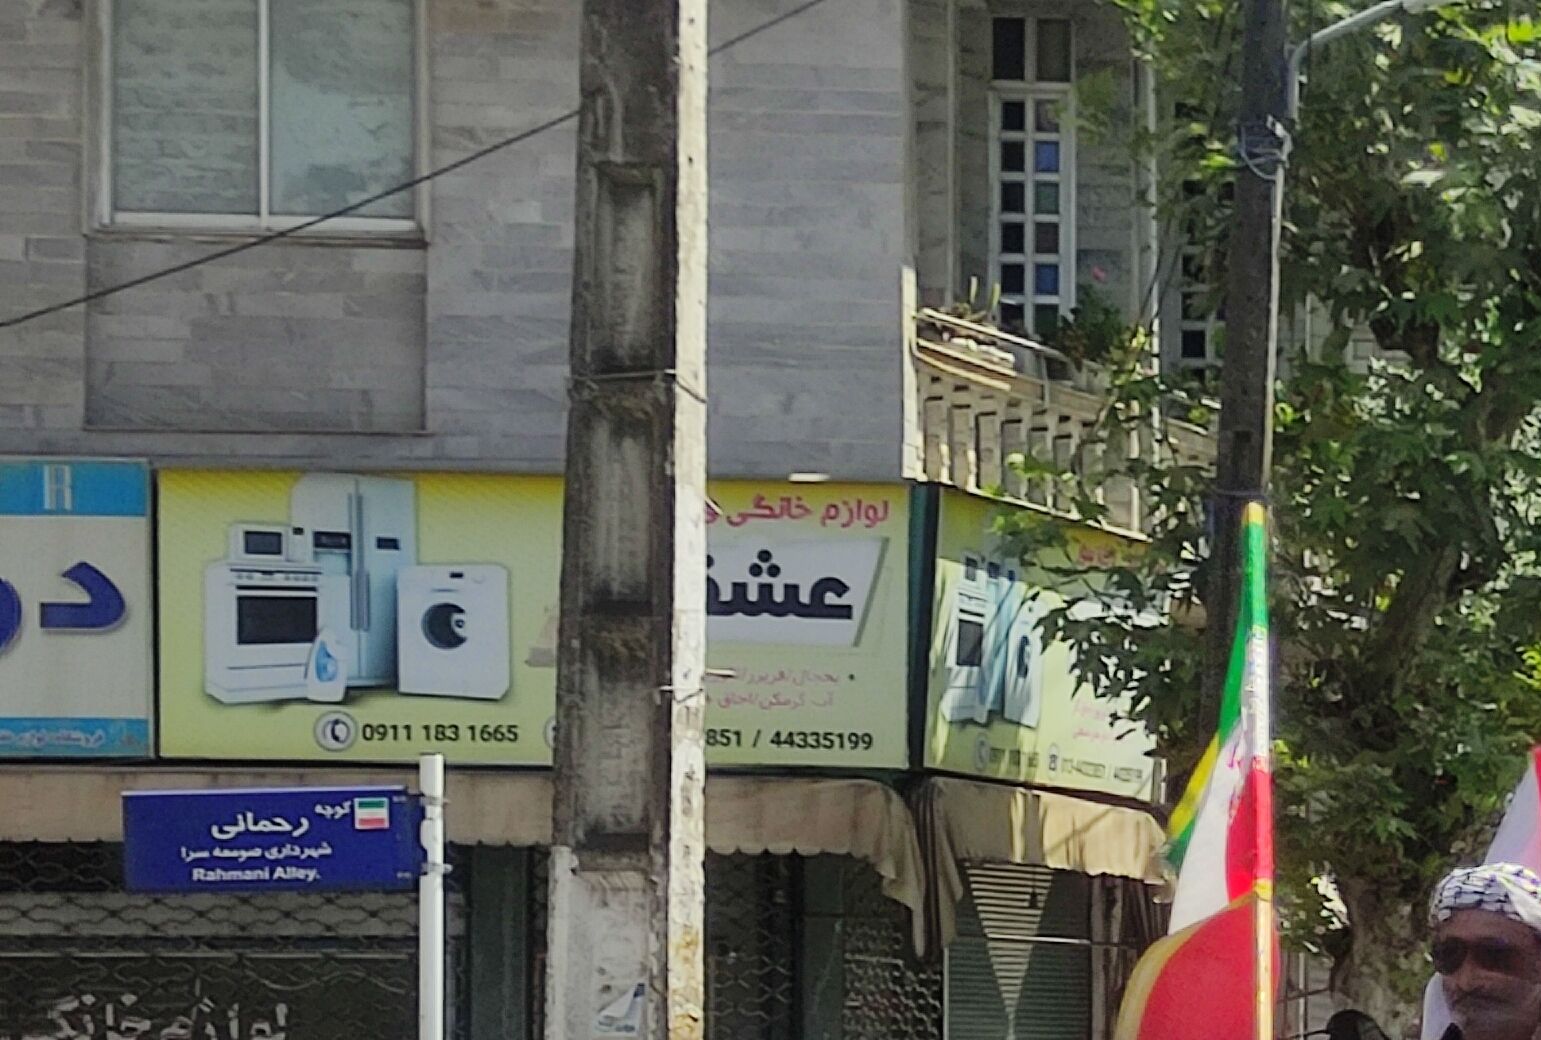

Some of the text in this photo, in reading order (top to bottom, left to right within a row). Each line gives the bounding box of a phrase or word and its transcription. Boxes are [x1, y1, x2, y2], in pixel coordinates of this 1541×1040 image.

[726, 493, 813, 527] خانگی
[820, 500, 889, 528] لوازم
[362, 723, 519, 742] 0911 183 1665
[706, 728, 742, 746] 851
[770, 730, 873, 750] 44335199
[314, 801, 352, 818] کوچه
[210, 812, 310, 839] رحمانی
[213, 844, 262, 862] صومعه
[264, 842, 333, 861] شهرداری
[192, 866, 270, 882] Rahmani
